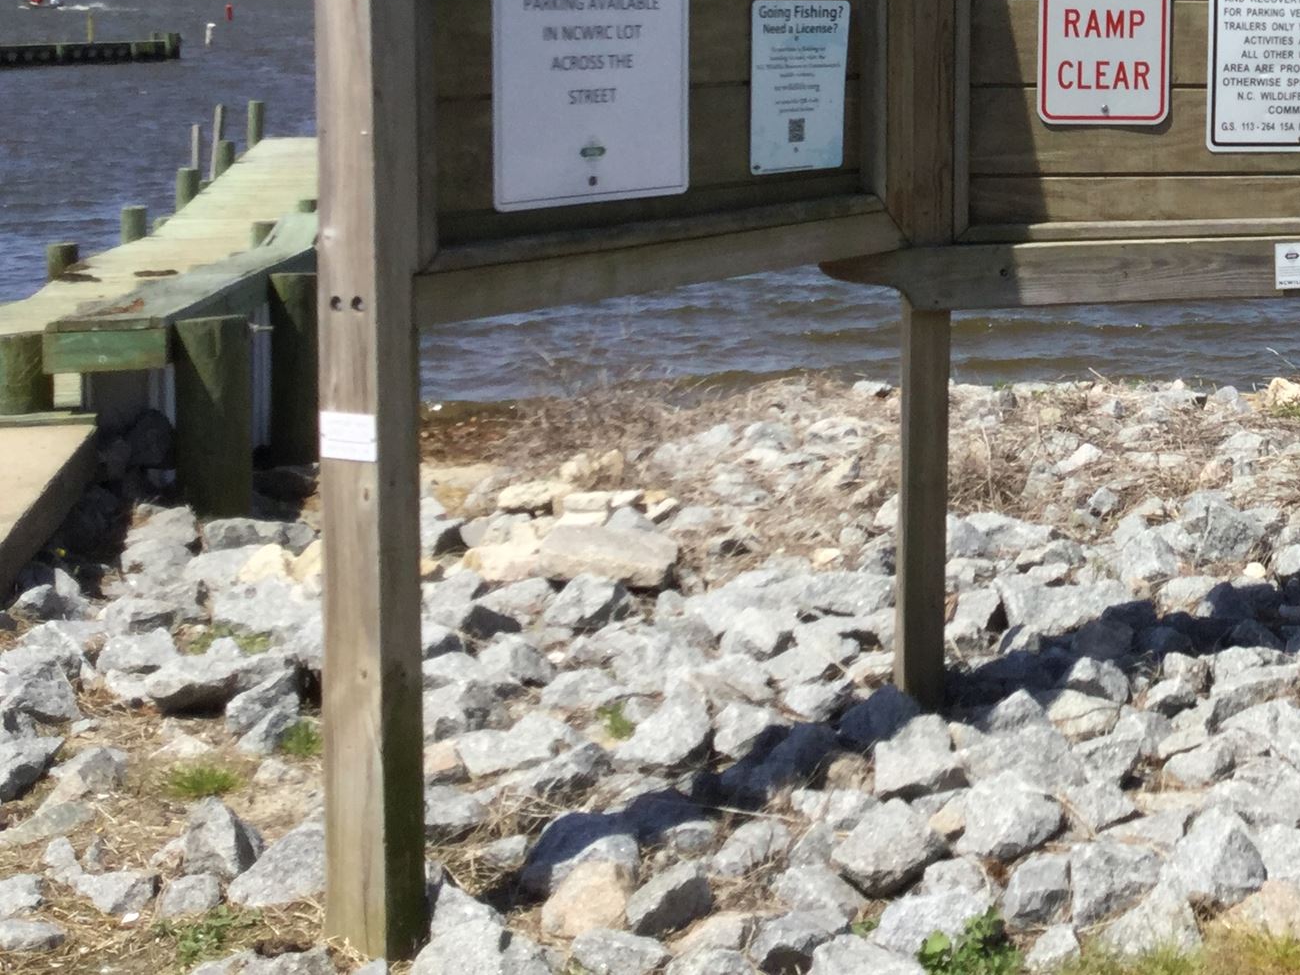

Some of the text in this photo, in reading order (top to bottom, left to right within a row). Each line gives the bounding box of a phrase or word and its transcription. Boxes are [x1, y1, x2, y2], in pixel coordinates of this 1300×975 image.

[759, 6, 843, 22] Going Fishing?
[1224, 8, 1241, 17] FOR
[1247, 8, 1285, 18] PARKING
[763, 24, 838, 34] Need a License?
[1064, 9, 1145, 39] RAMP
[1224, 22, 1267, 32] TRAILERS
[1272, 22, 1295, 32] ONLY
[542, 26, 559, 41] IN
[616, 25, 642, 39] LOT
[1244, 36, 1294, 46] ACTIVITIES
[1241, 50, 1258, 59] ALL
[1263, 51, 1294, 60] OTHER
[552, 55, 633, 71] ACROSS THE
[1223, 64, 1250, 73] AREA
[1255, 65, 1274, 73] ARE
[1058, 61, 1150, 90] CLEAR
[1223, 78, 1281, 87] OTHERWISE
[569, 89, 616, 105] STREET
[1237, 92, 1255, 101] N.C.
[1280, 123, 1294, 131] 15A
